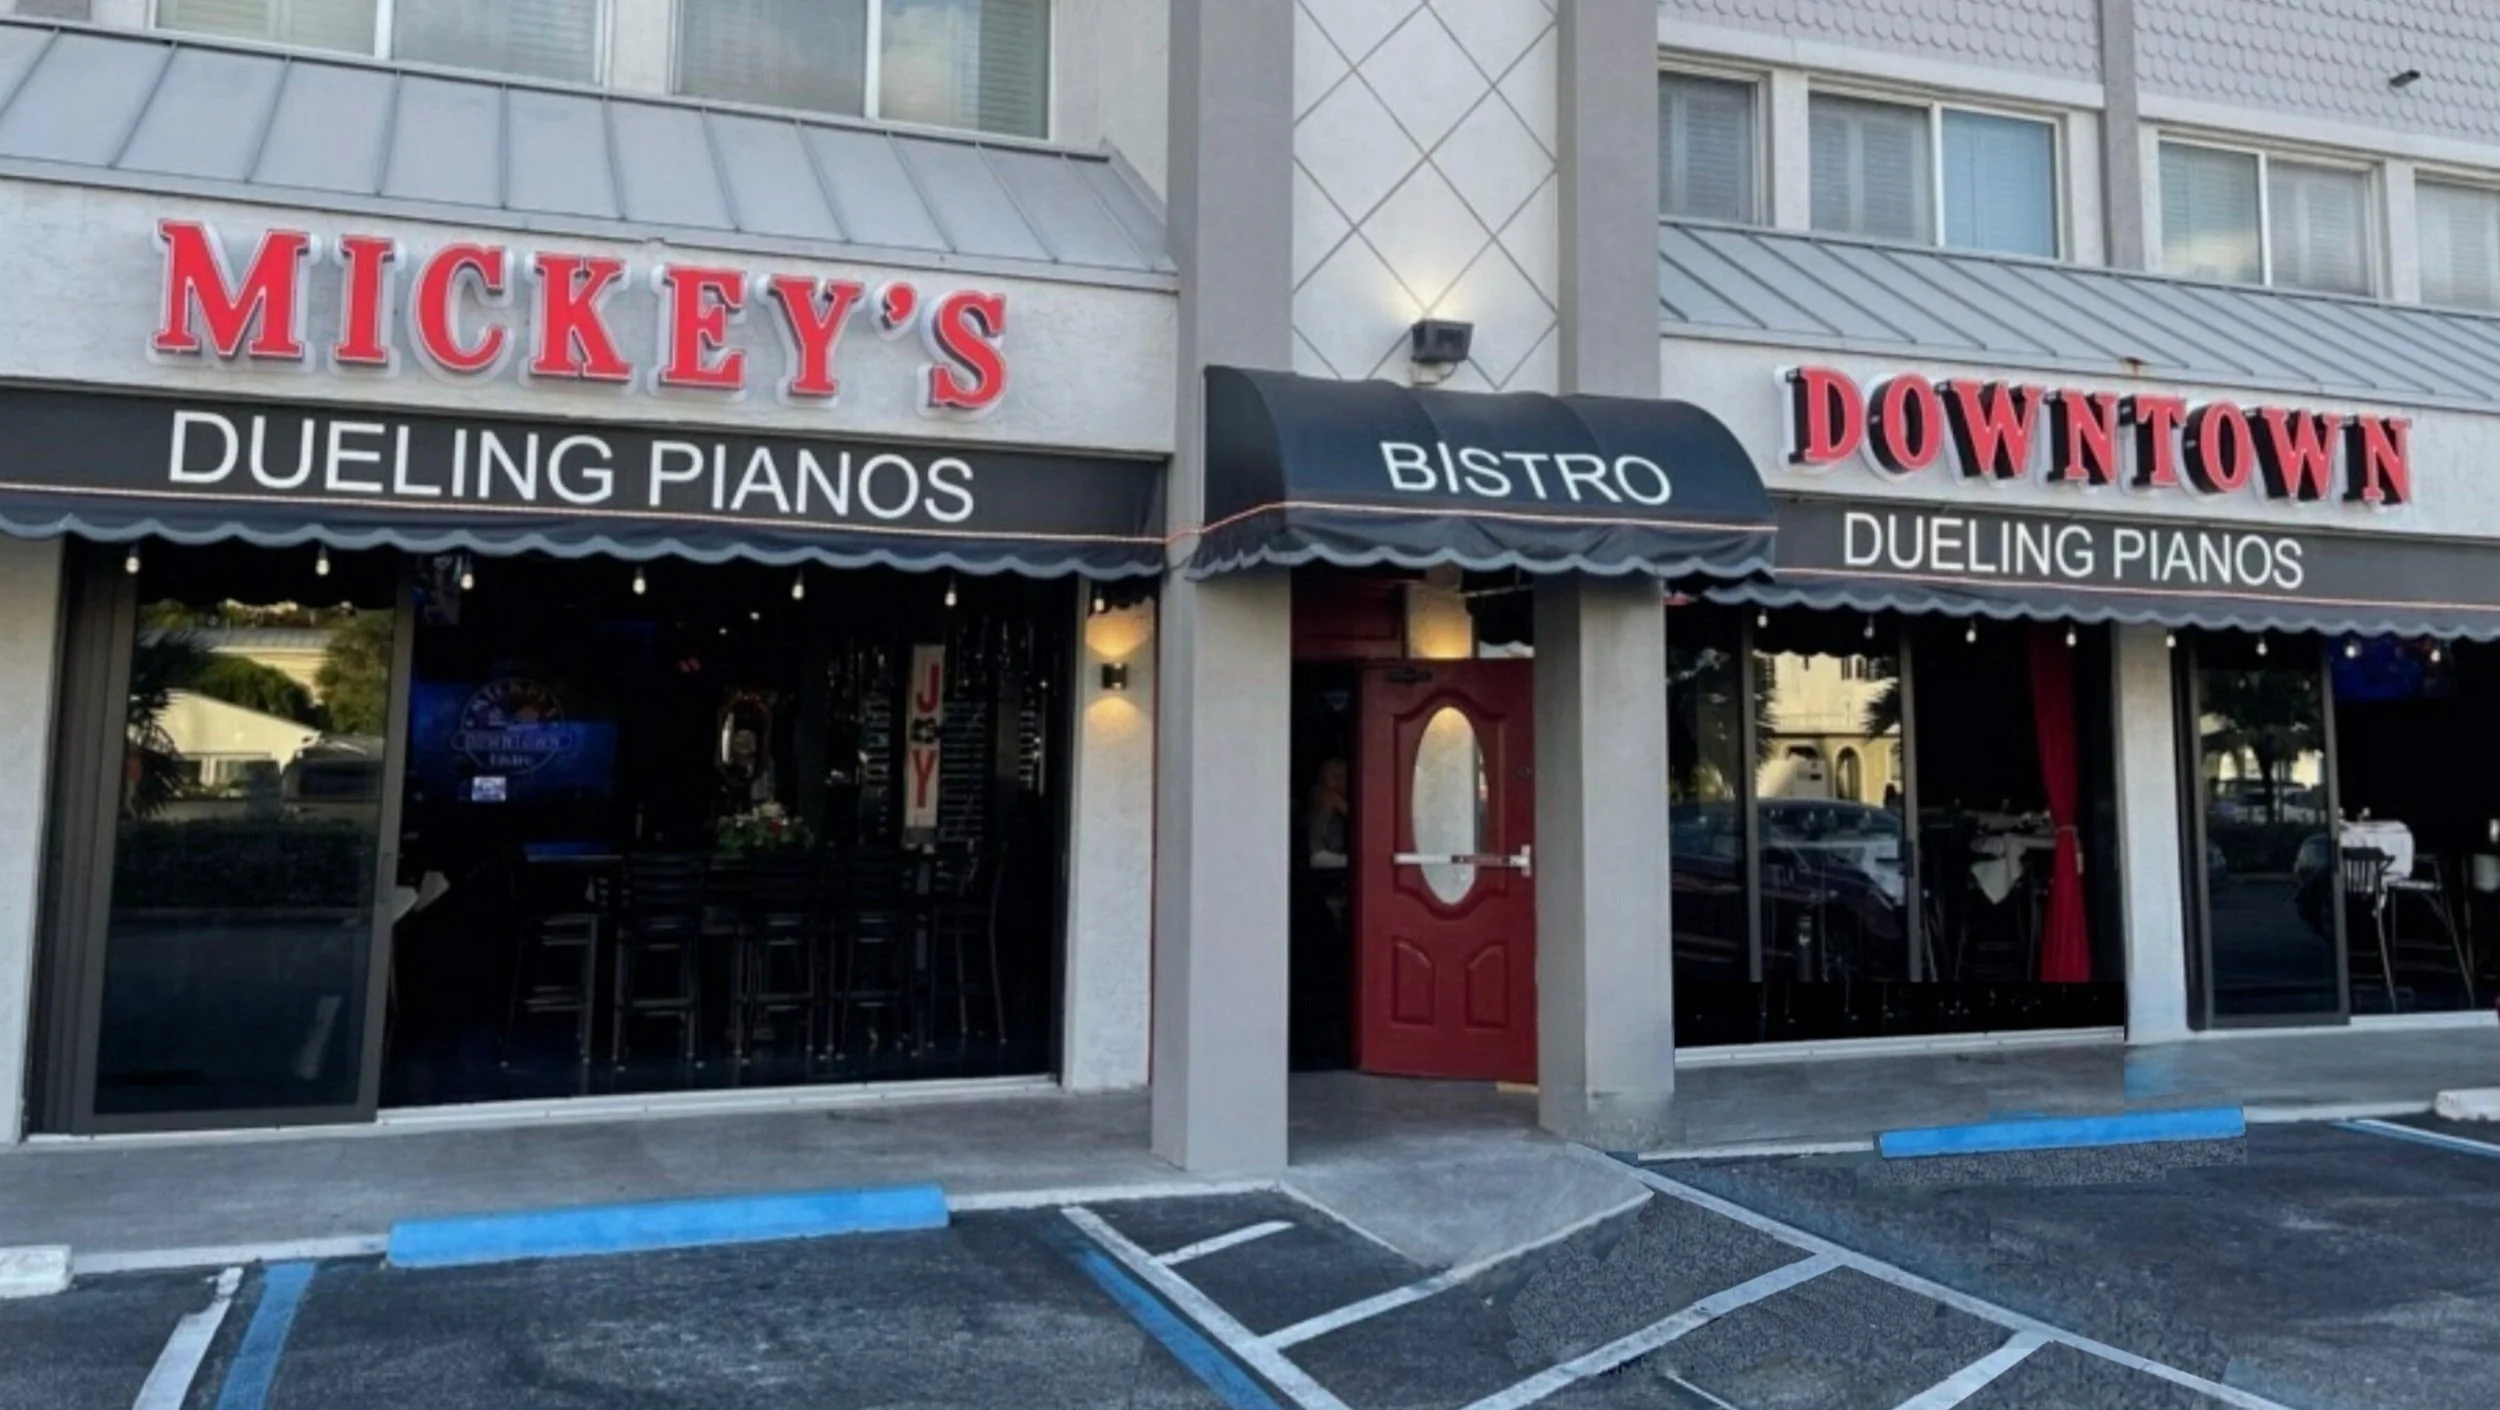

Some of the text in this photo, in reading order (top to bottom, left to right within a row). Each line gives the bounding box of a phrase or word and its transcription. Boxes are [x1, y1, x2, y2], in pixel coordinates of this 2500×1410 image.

[154, 218, 1007, 409] MICKEY'S
[168, 410, 974, 523] DUELING PIANOS
[1379, 440, 1672, 506] BISTRO
[1788, 365, 2413, 506] DOWNTOWN
[1843, 512, 2305, 590] DUELING PIANOS
